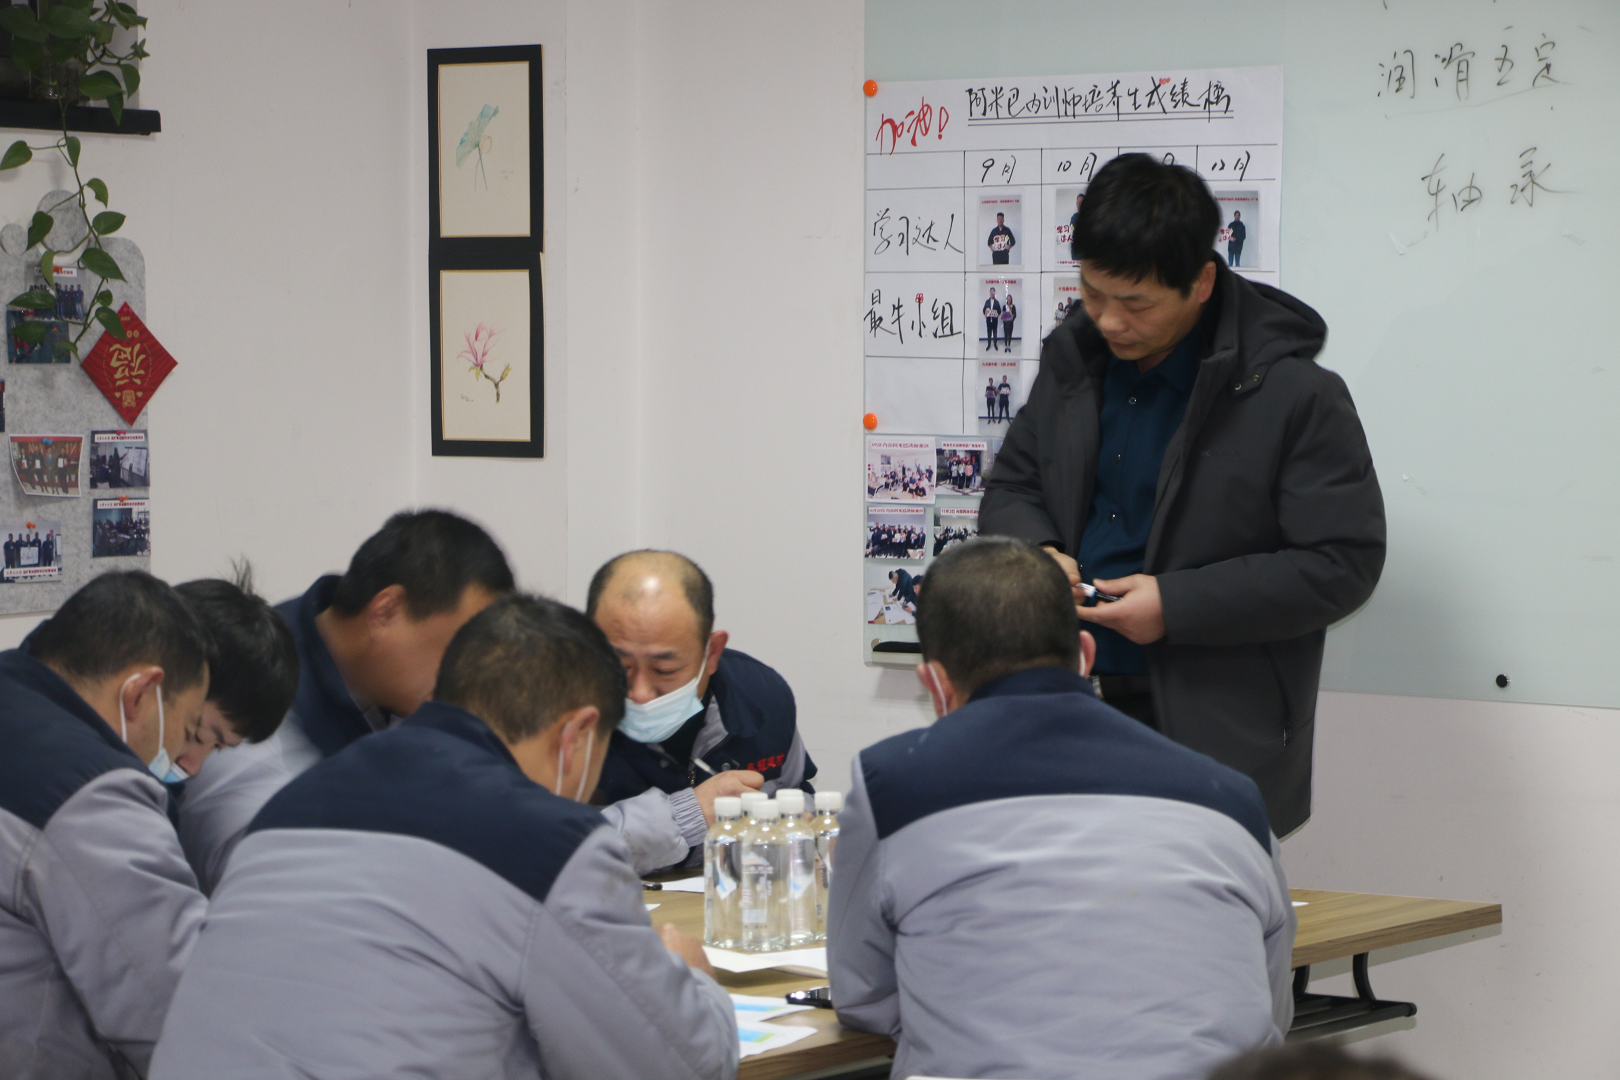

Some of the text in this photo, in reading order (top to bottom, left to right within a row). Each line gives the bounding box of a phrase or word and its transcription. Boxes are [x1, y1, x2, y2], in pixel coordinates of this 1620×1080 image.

[1376, 26, 1565, 101] 润滑五定
[1421, 147, 1577, 231] 轴承
[873, 207, 964, 256] 学习达人
[863, 288, 963, 345] 最牛小组
[109, 343, 146, 386] 福
